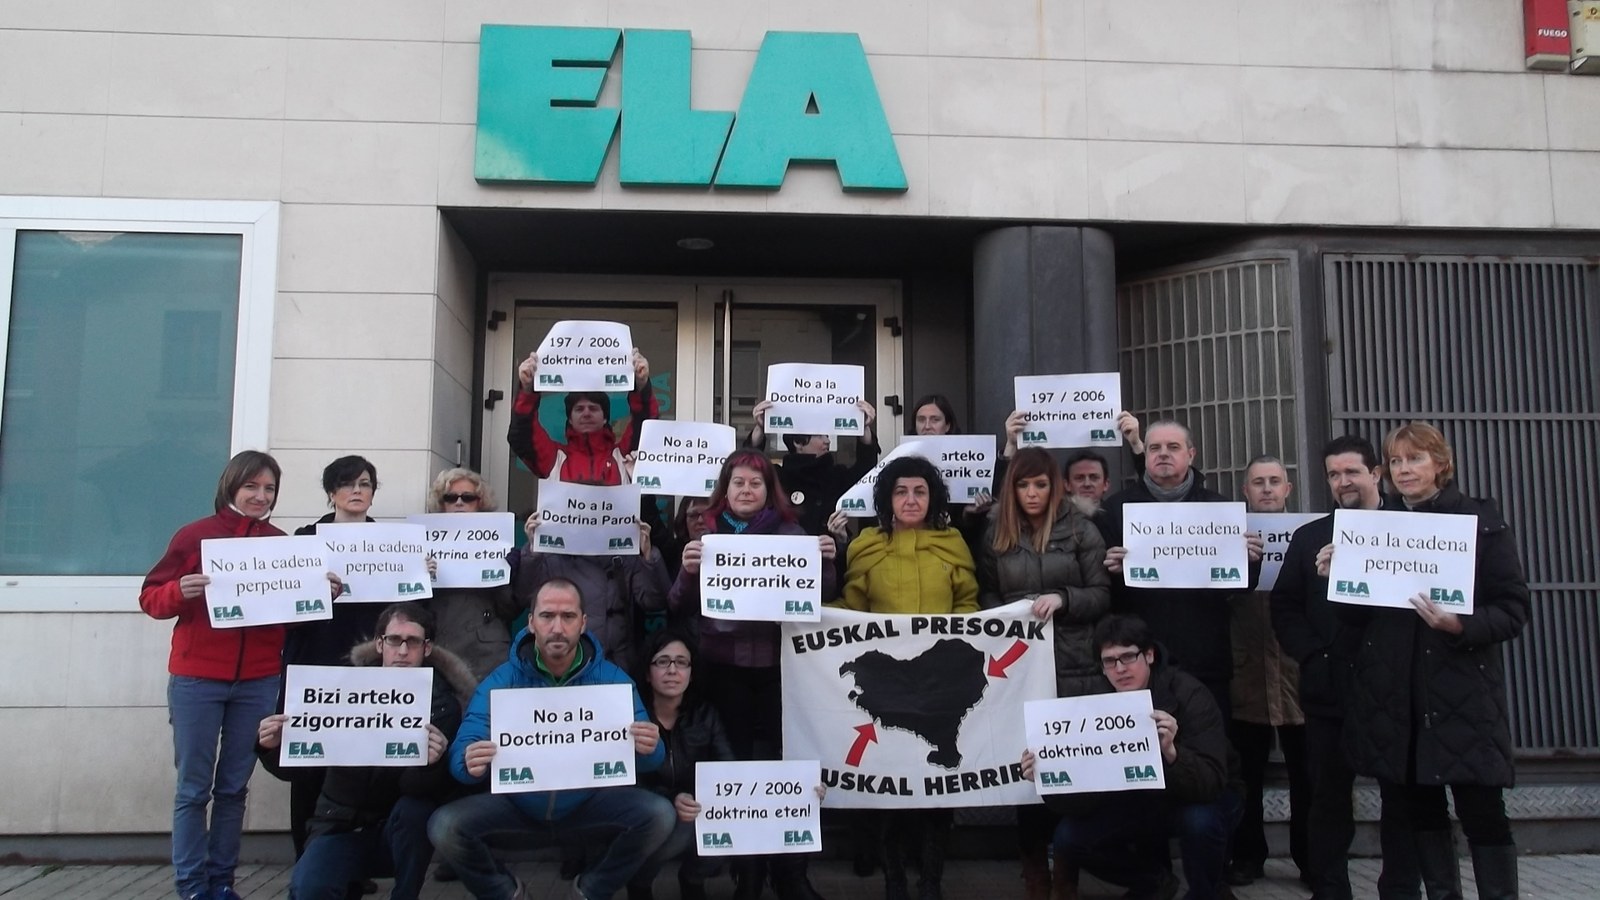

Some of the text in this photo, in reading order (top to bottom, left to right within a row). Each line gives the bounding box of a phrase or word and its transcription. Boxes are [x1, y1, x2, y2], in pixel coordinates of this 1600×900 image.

[1537, 28, 1568, 38] FUEGO
[474, 24, 909, 192] ELA
[551, 337, 620, 348] 197 / 2006
[542, 354, 627, 365] doktrina eten!
[540, 374, 563, 384] ELA
[605, 374, 628, 384] ELA
[795, 378, 836, 389] No a la
[771, 392, 861, 406] Doctrina Parot
[1032, 390, 1105, 404] 197 / 2006
[770, 416, 793, 426] ELA
[1022, 408, 1113, 423] doktrina eten!
[835, 418, 858, 428] ELA
[1023, 431, 1047, 440] ELA
[1091, 430, 1116, 439] ELA
[664, 436, 708, 449] No a la
[638, 451, 727, 464] Doctrina Paro
[942, 450, 985, 461] arteko
[976, 469, 991, 478] ez
[568, 498, 613, 511] No a la
[841, 499, 866, 508] ELA
[542, 510, 638, 526] Doctrina Parot
[1131, 522, 1240, 535] No a la cadena
[426, 530, 499, 542] 197 / 2006
[540, 535, 565, 546] ELA
[609, 537, 633, 547] ELA
[1268, 531, 1292, 543] art
[1341, 530, 1467, 552] No a la cadena
[326, 540, 422, 553] No a la cadena
[1153, 545, 1217, 559] perpetua
[474, 548, 507, 559] eten!
[211, 555, 322, 572] No a la cadena
[716, 553, 807, 568] Bizi arteko
[1365, 559, 1438, 575] perpetua
[346, 562, 403, 575] perpetua
[481, 569, 505, 579] ELA
[1130, 567, 1159, 578] ELA
[1211, 567, 1240, 578] ELA
[236, 579, 301, 597] perpetua
[398, 583, 425, 593] ELA
[707, 574, 815, 590] zigorrarik ez
[1336, 580, 1370, 594] ELA
[1430, 588, 1465, 603] ELA
[296, 600, 325, 611] ELA
[707, 598, 735, 610] ELA
[785, 600, 813, 612] ELA
[213, 605, 244, 618] ELA
[791, 617, 1046, 654] EUSKAL PRESOAK
[304, 688, 414, 704] Bizi arteko
[534, 707, 593, 723] No a la
[291, 712, 422, 732] zigorrarik ez
[1044, 715, 1135, 735] 197 / 2006
[500, 727, 627, 747] Doctrina Parot
[289, 742, 324, 756] ELA
[386, 742, 420, 755] ELA
[1039, 737, 1149, 759] doktrina eten!
[499, 768, 533, 781] ELA
[594, 762, 626, 776] ELA
[1124, 766, 1156, 779] ELA
[821, 762, 1025, 796] USKAL HERRIR
[1040, 772, 1071, 784] ELA
[716, 782, 802, 796] 197 / 2006
[705, 804, 810, 820] doktrina eten!
[702, 833, 732, 846] ELA
[784, 830, 813, 843] ELA
